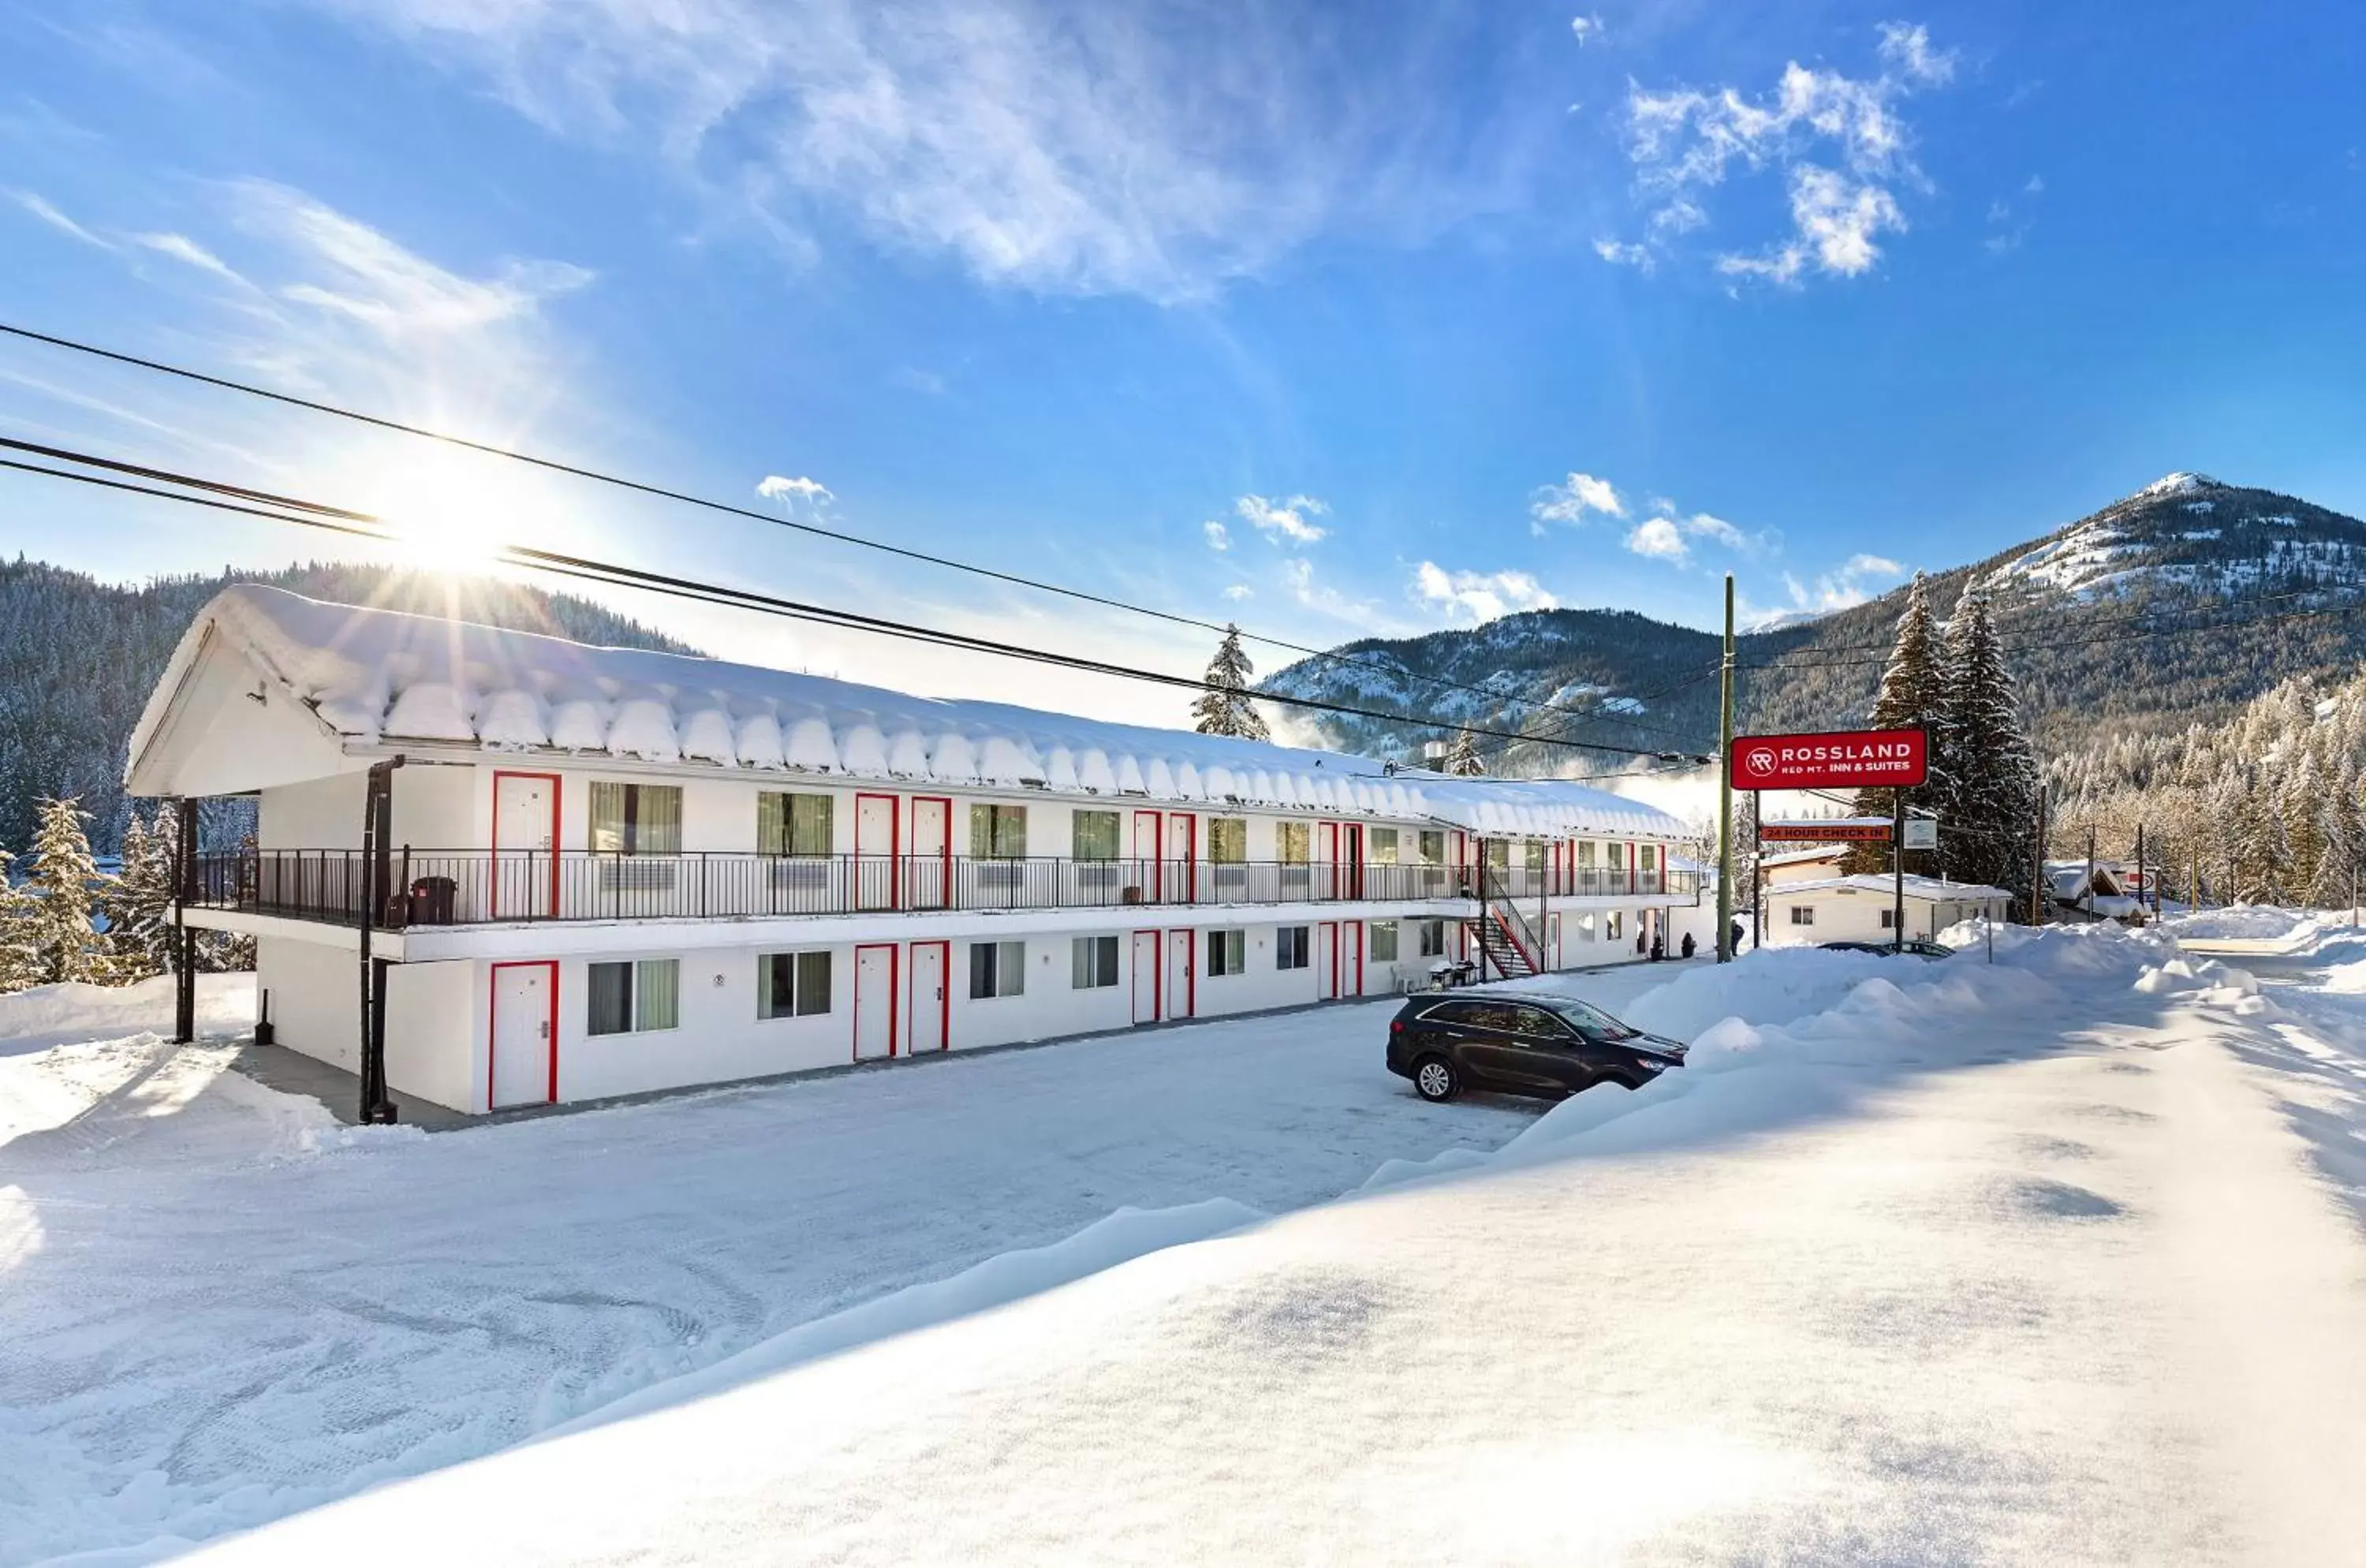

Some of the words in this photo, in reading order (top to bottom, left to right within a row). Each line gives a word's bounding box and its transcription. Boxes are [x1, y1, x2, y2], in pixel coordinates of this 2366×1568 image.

[1782, 744, 1911, 761] ROSSLAND
[1829, 763, 1851, 772] INN
[1854, 763, 1862, 771] &
[1865, 761, 1910, 771] SUITES
[1870, 828, 1883, 837] IN
